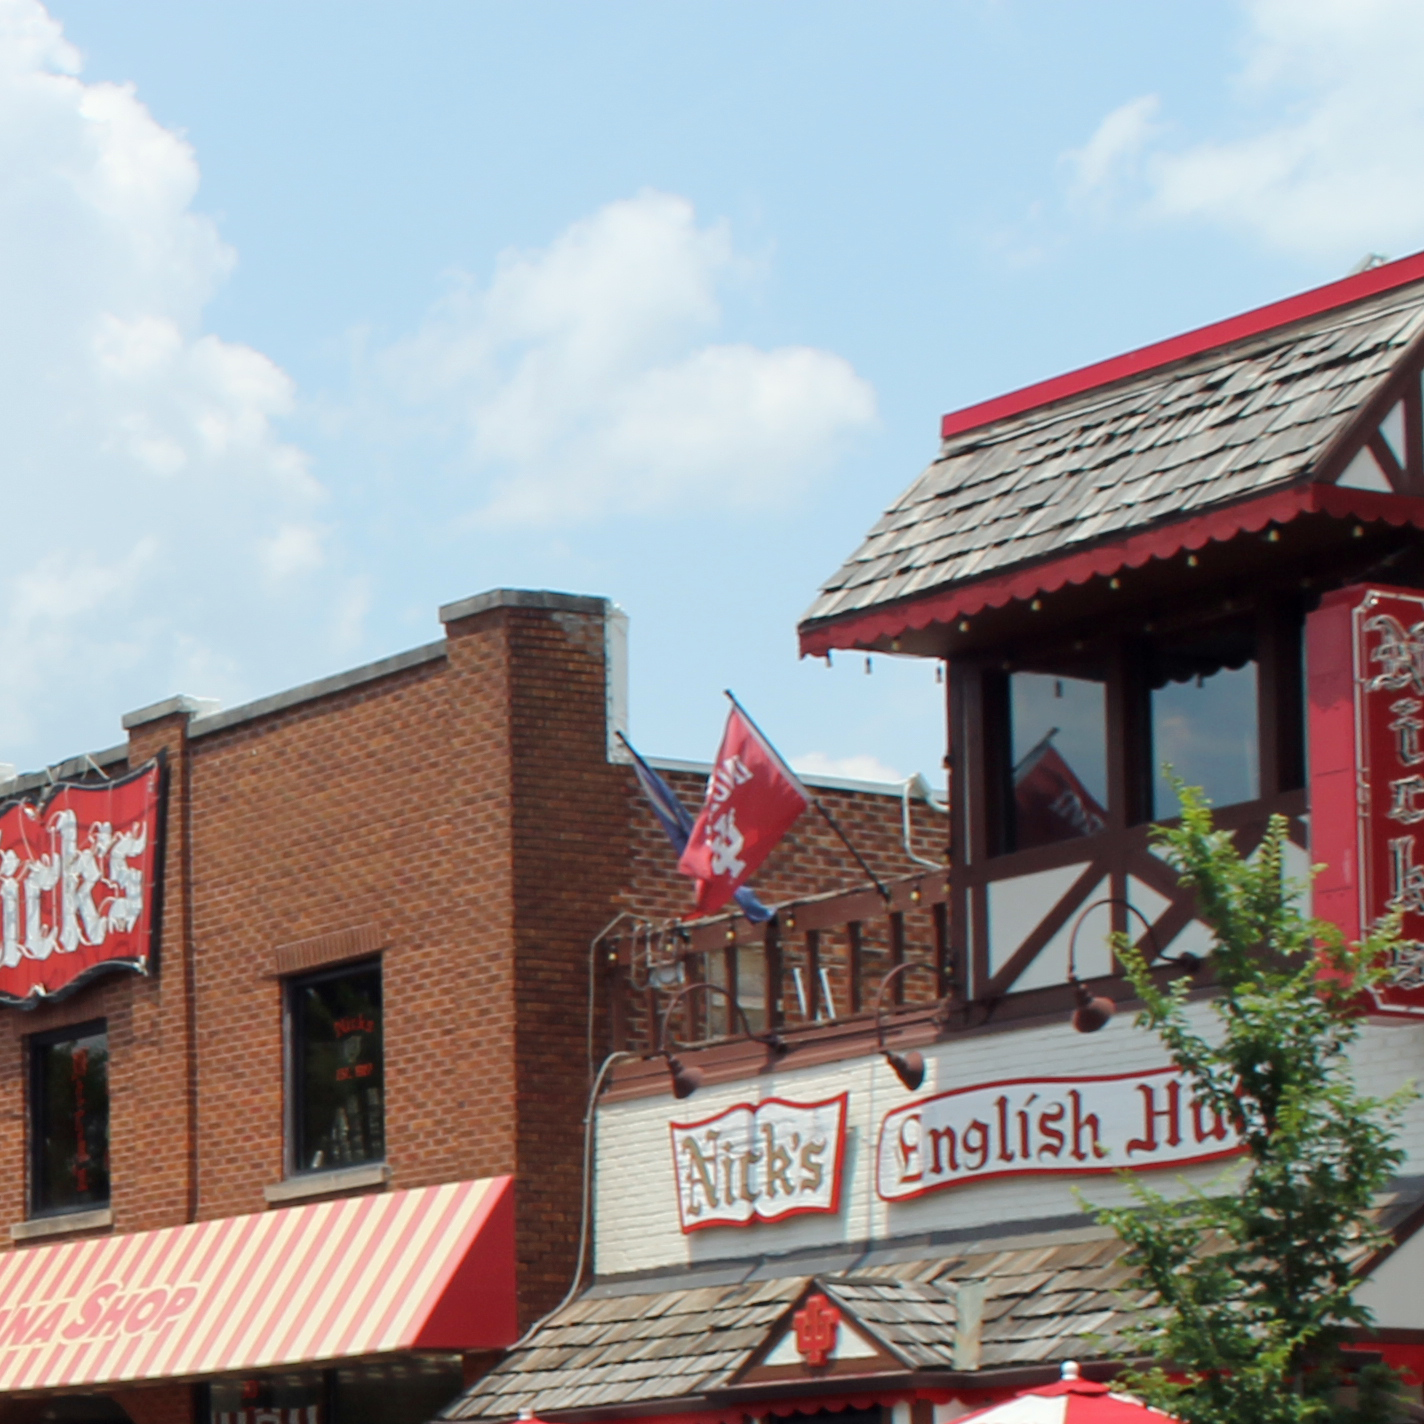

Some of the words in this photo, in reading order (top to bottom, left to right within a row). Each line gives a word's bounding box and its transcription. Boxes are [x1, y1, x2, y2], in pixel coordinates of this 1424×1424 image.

[682, 1120, 826, 1217] Nick's
[896, 1088, 1106, 1184] English
[60, 1281, 199, 1341] SHOP
